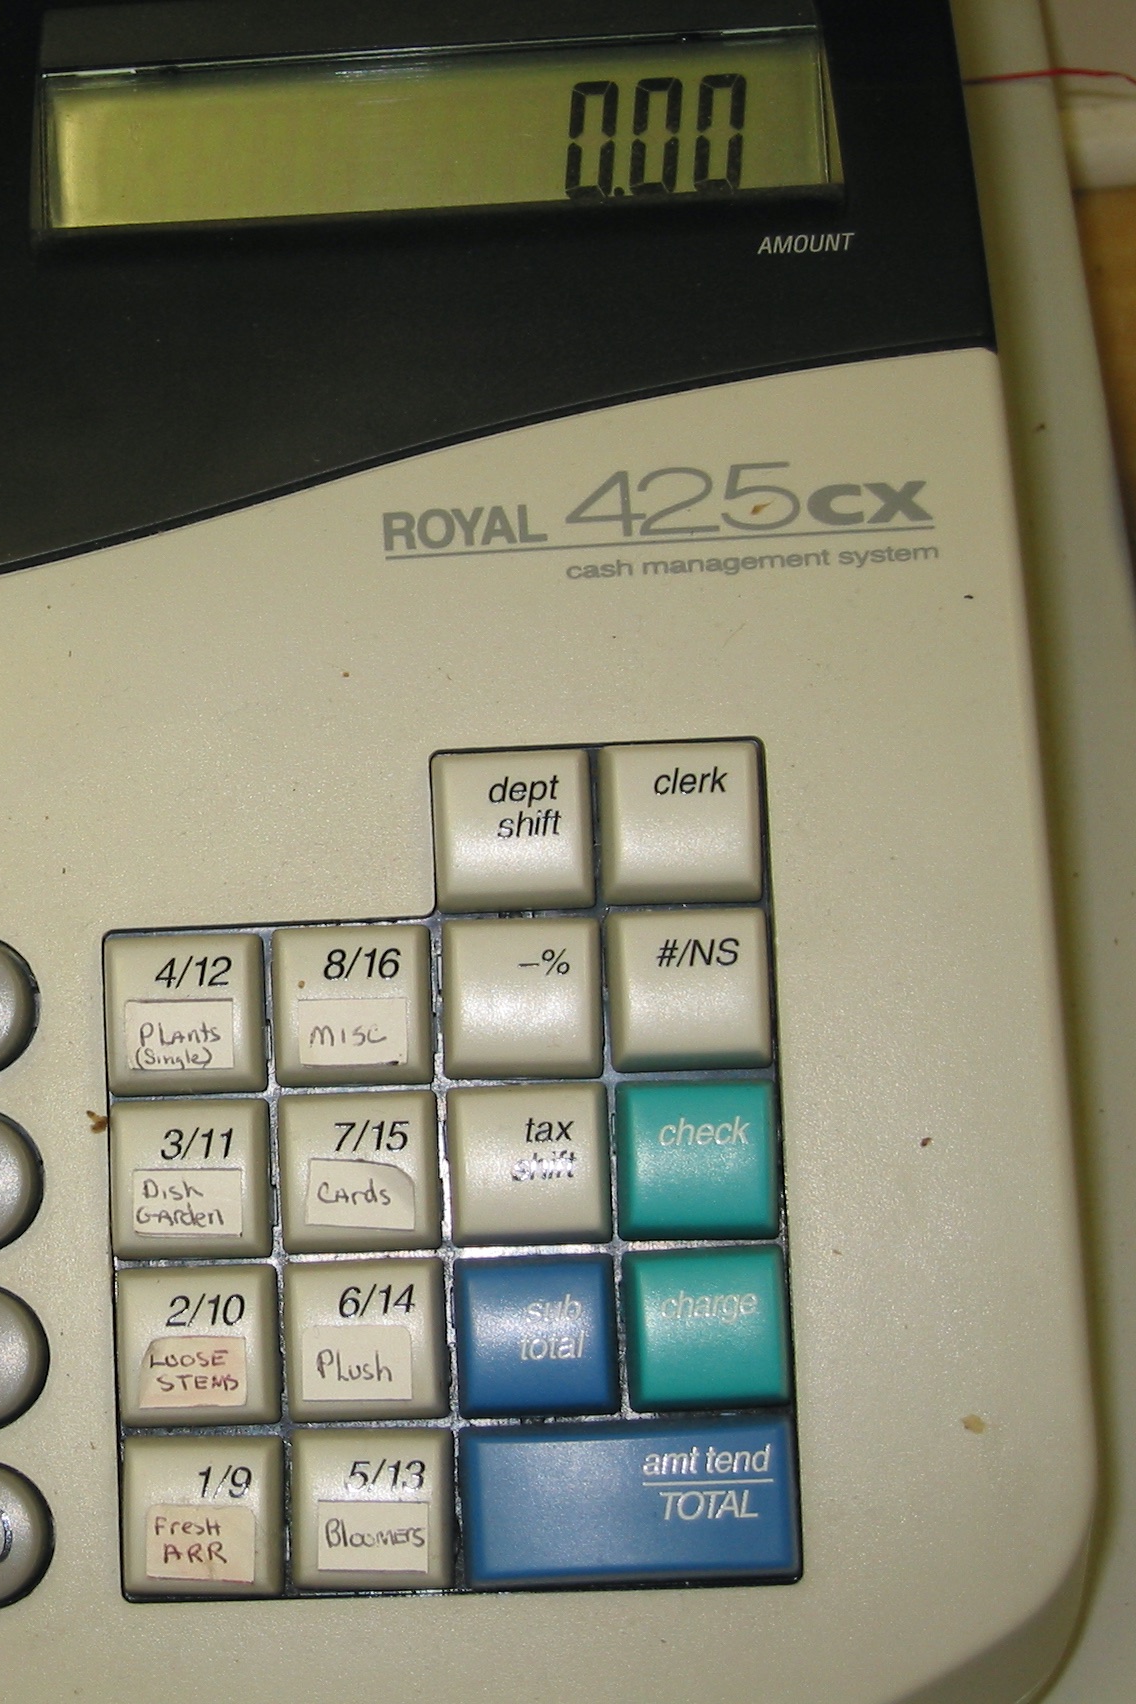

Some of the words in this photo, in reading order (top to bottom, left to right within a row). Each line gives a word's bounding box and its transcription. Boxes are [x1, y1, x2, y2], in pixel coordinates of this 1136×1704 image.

[565, 73, 747, 199] 0.00
[757, 232, 856, 256] AMOUNT
[382, 504, 548, 552] ROYAL
[565, 558, 633, 580] cash
[642, 549, 830, 578] management
[839, 544, 939, 569] system
[488, 774, 559, 808] dept
[653, 766, 728, 795] clerk
[497, 809, 562, 839] shift
[323, 947, 402, 980] 8/16
[656, 937, 740, 968] #/NS
[155, 955, 232, 989] 4/12
[135, 1046, 213, 1070] (Single)
[160, 1126, 234, 1160] 3/11
[333, 1119, 411, 1152] 7/15
[525, 1117, 575, 1143] tax
[658, 1115, 750, 1146] check
[512, 1150, 577, 1181] shift
[165, 1293, 245, 1328] 2/10
[338, 1283, 416, 1318] 6/14
[526, 1294, 582, 1324] sub
[661, 1290, 758, 1325] charge
[520, 1330, 584, 1361] total
[343, 1459, 426, 1493] 5/13
[642, 1446, 700, 1476] amt
[705, 1443, 771, 1474] tend
[198, 1465, 252, 1499] 1/9
[659, 1489, 759, 1521] TOTAL
[163, 1540, 228, 1564] ARR
